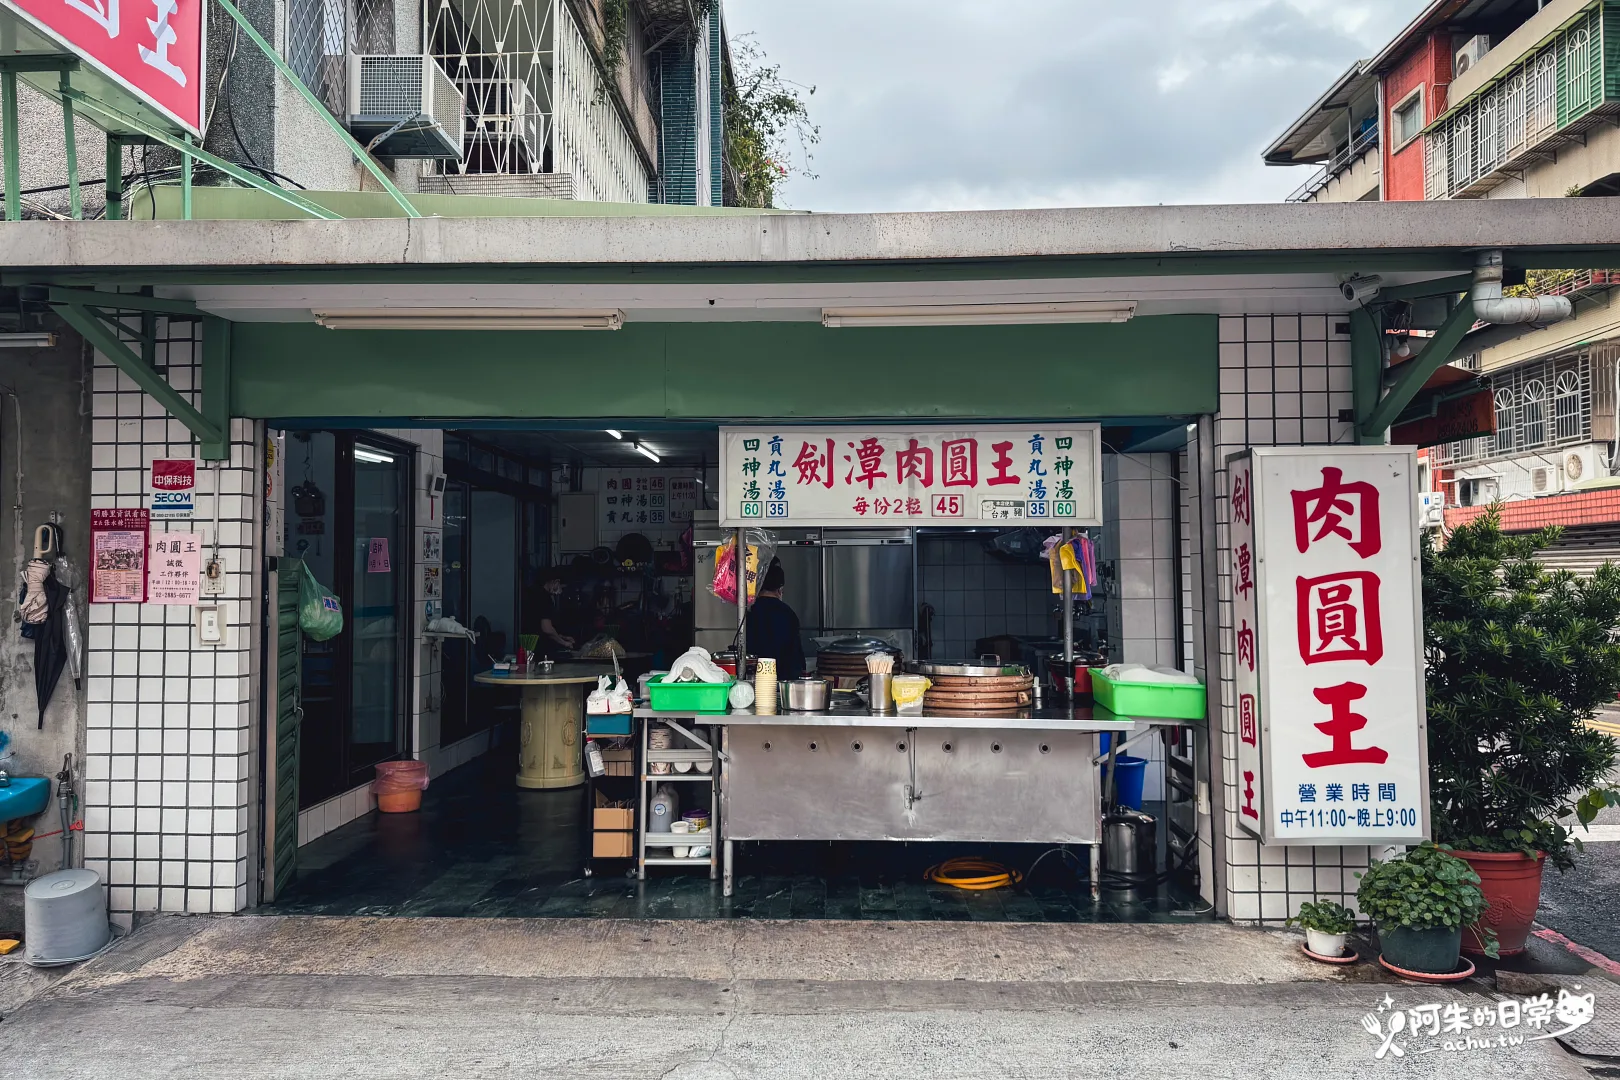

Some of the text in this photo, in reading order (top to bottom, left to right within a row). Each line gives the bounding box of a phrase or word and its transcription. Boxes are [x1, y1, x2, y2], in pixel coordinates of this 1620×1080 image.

[792, 438, 1021, 489] 劍潭肉圓王
[154, 474, 192, 486] 中保科技
[606, 478, 632, 490] 肉圓
[742, 438, 761, 517] 四神湯 60
[767, 435, 787, 516] 貢丸湯 35
[1028, 434, 1047, 515] 貢丸湯 35
[1054, 437, 1074, 515] 四神湯 60
[154, 492, 191, 502] SECOM
[606, 493, 663, 507] 四神湯 60
[853, 496, 959, 515] 每份2粒 45
[606, 509, 648, 524] 貢丸湯
[155, 540, 197, 554] 肉圓王
[1290, 467, 1389, 769] 肉圓王
[1231, 468, 1259, 820] 劍潭肉圓王
[1298, 783, 1397, 803] 營業時間
[1279, 808, 1417, 828] 中午11:00~晚上9:00
